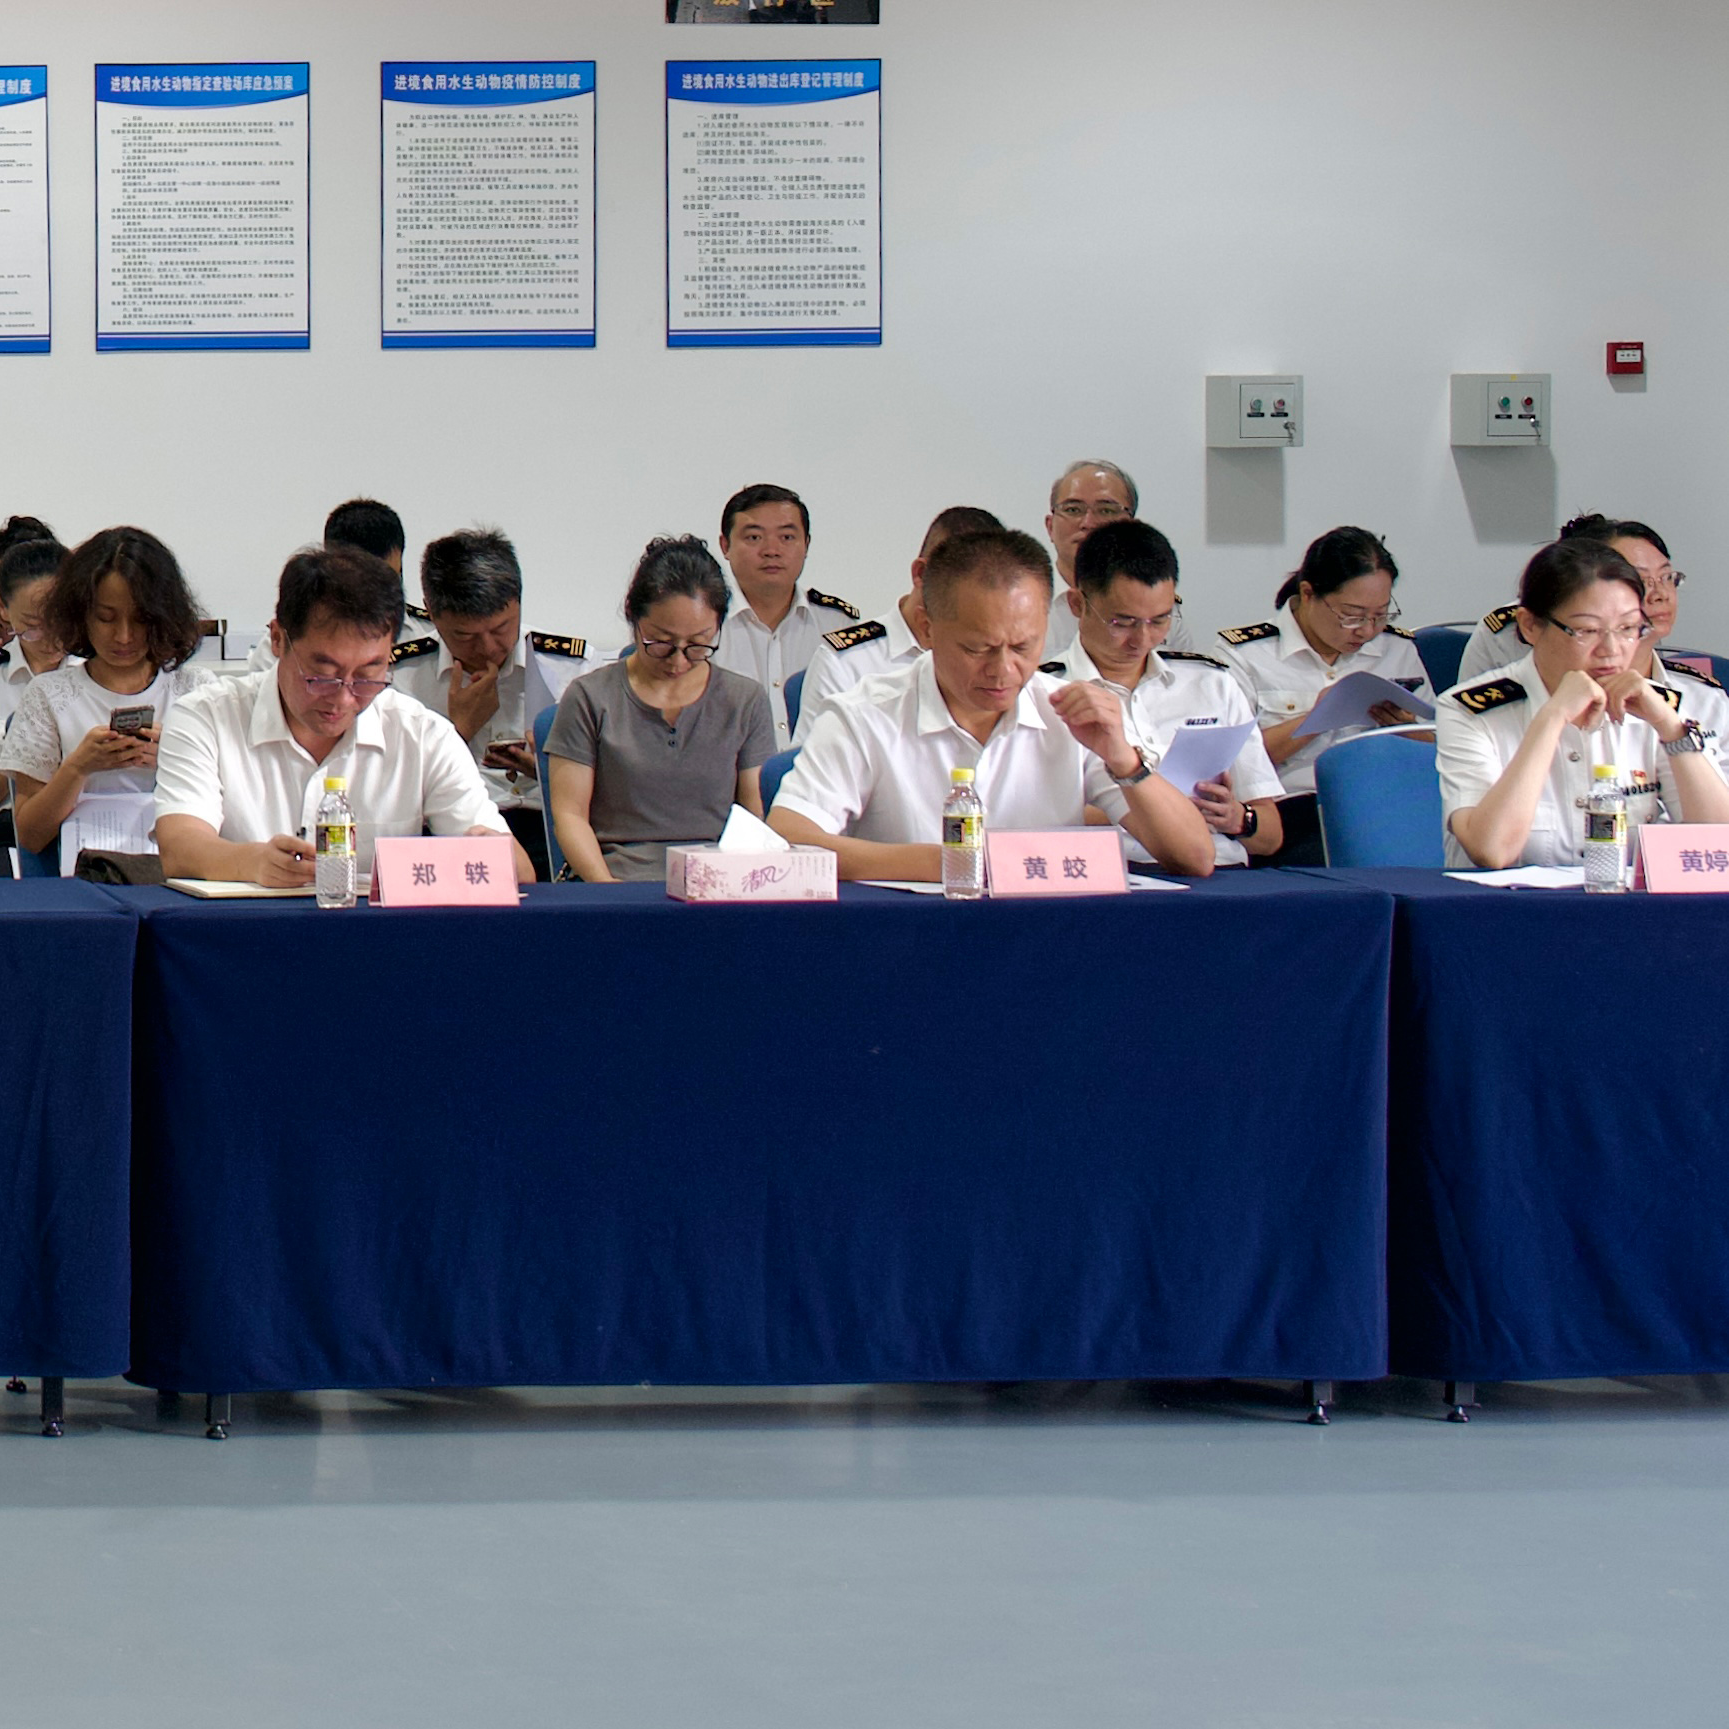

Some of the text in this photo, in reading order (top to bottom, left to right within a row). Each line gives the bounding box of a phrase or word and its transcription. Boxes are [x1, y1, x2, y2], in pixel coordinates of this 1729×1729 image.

[394, 73, 581, 91] 进境食用水生动物疫情防控制度
[412, 861, 490, 887] 郑轶
[742, 865, 792, 892] 清风
[1022, 855, 1089, 880] 黄蛟
